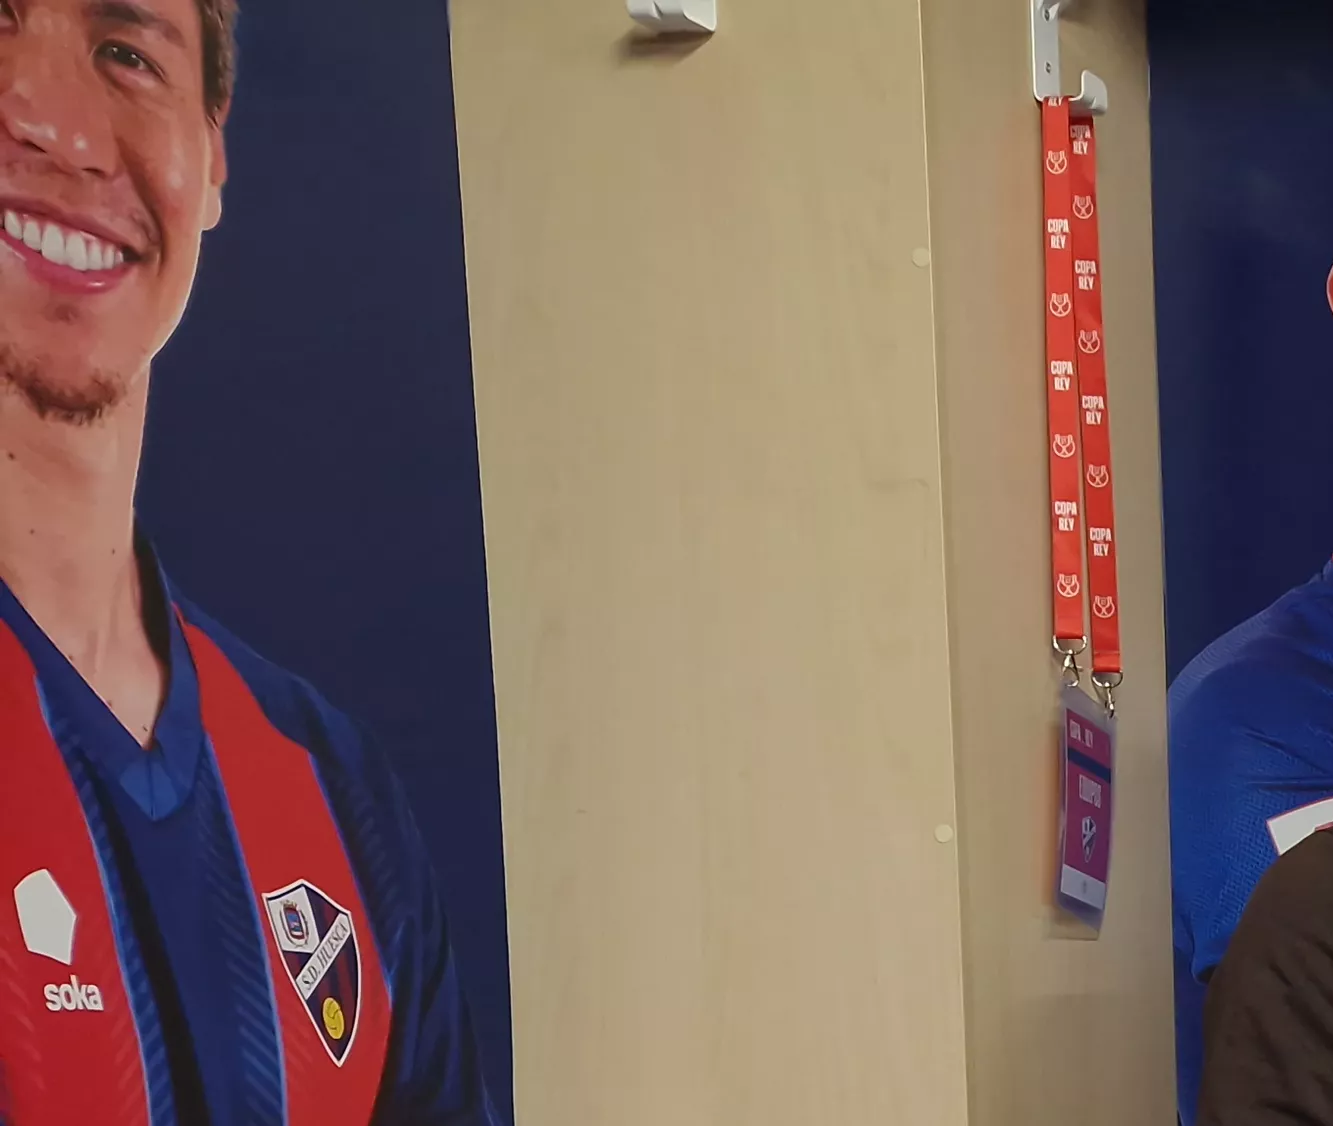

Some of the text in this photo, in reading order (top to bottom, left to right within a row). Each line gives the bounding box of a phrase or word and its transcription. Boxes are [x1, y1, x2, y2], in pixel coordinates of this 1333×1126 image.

[1047, 219, 1070, 233] COPA
[1074, 260, 1097, 274] COPA
[1050, 360, 1073, 375] COPA
[1081, 395, 1104, 409] COPA
[1054, 501, 1077, 515] COPA
[1089, 527, 1112, 541] COPA
[44, 974, 104, 1011] soka
